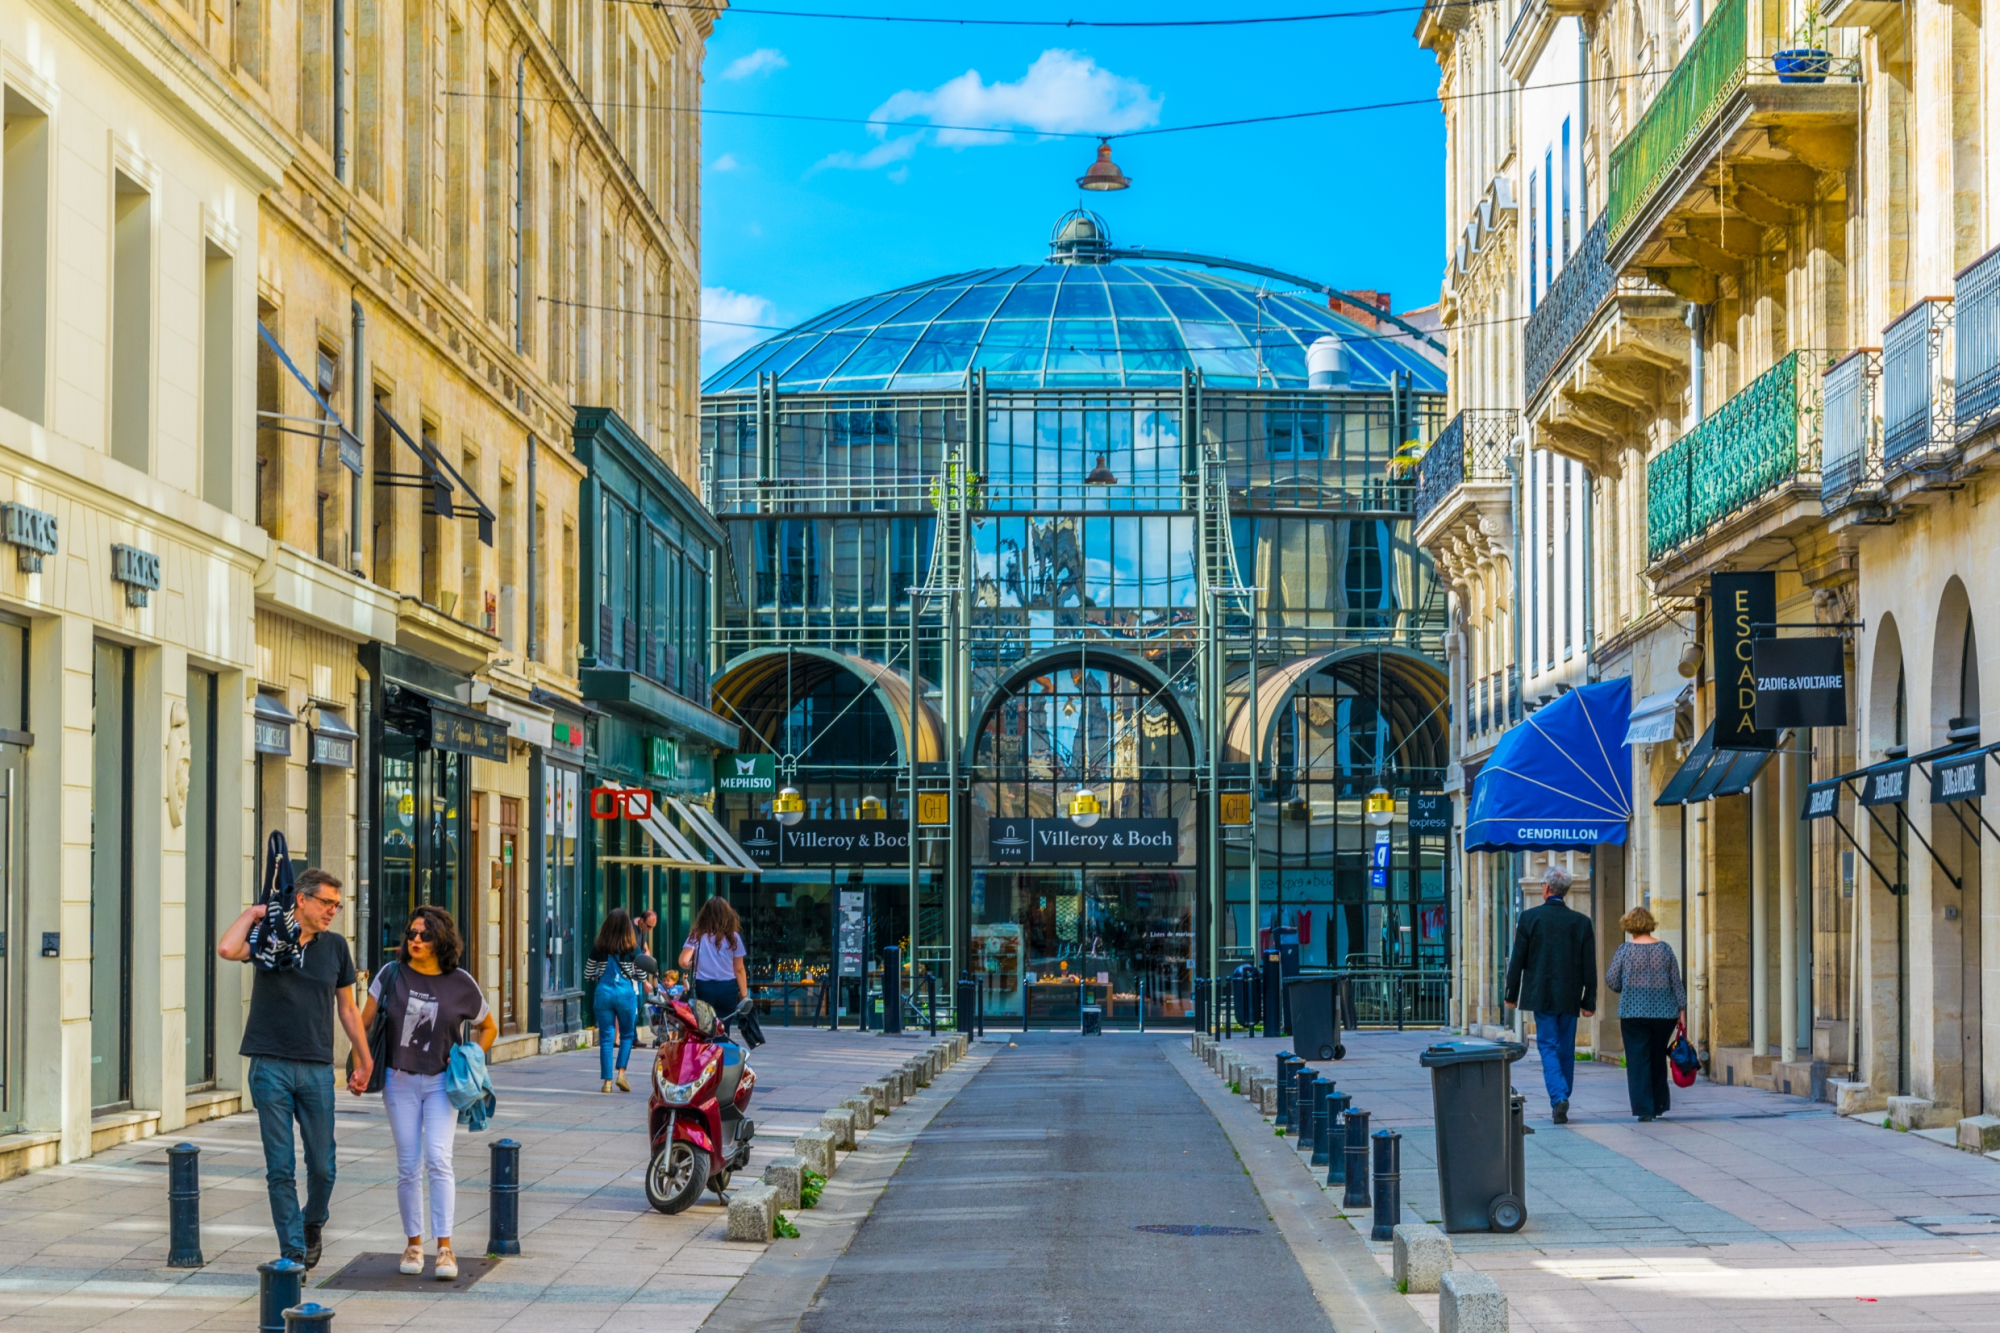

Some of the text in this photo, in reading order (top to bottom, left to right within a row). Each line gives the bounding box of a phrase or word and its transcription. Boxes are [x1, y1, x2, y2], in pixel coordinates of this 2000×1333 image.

[8, 501, 58, 555] IKKS
[117, 543, 160, 591] IKKS
[1735, 590, 1756, 733] ESCADA
[1757, 675, 1843, 691] ZADIG&VOLTAIRE
[720, 777, 772, 789] MEPHISTO
[1417, 797, 1436, 809] Sud
[1409, 818, 1446, 829] express
[787, 832, 855, 850] Villeroy
[858, 833, 871, 847] &
[1039, 830, 1173, 849] Villeroy & Boch
[1517, 828, 1598, 840] CENDRILLON
